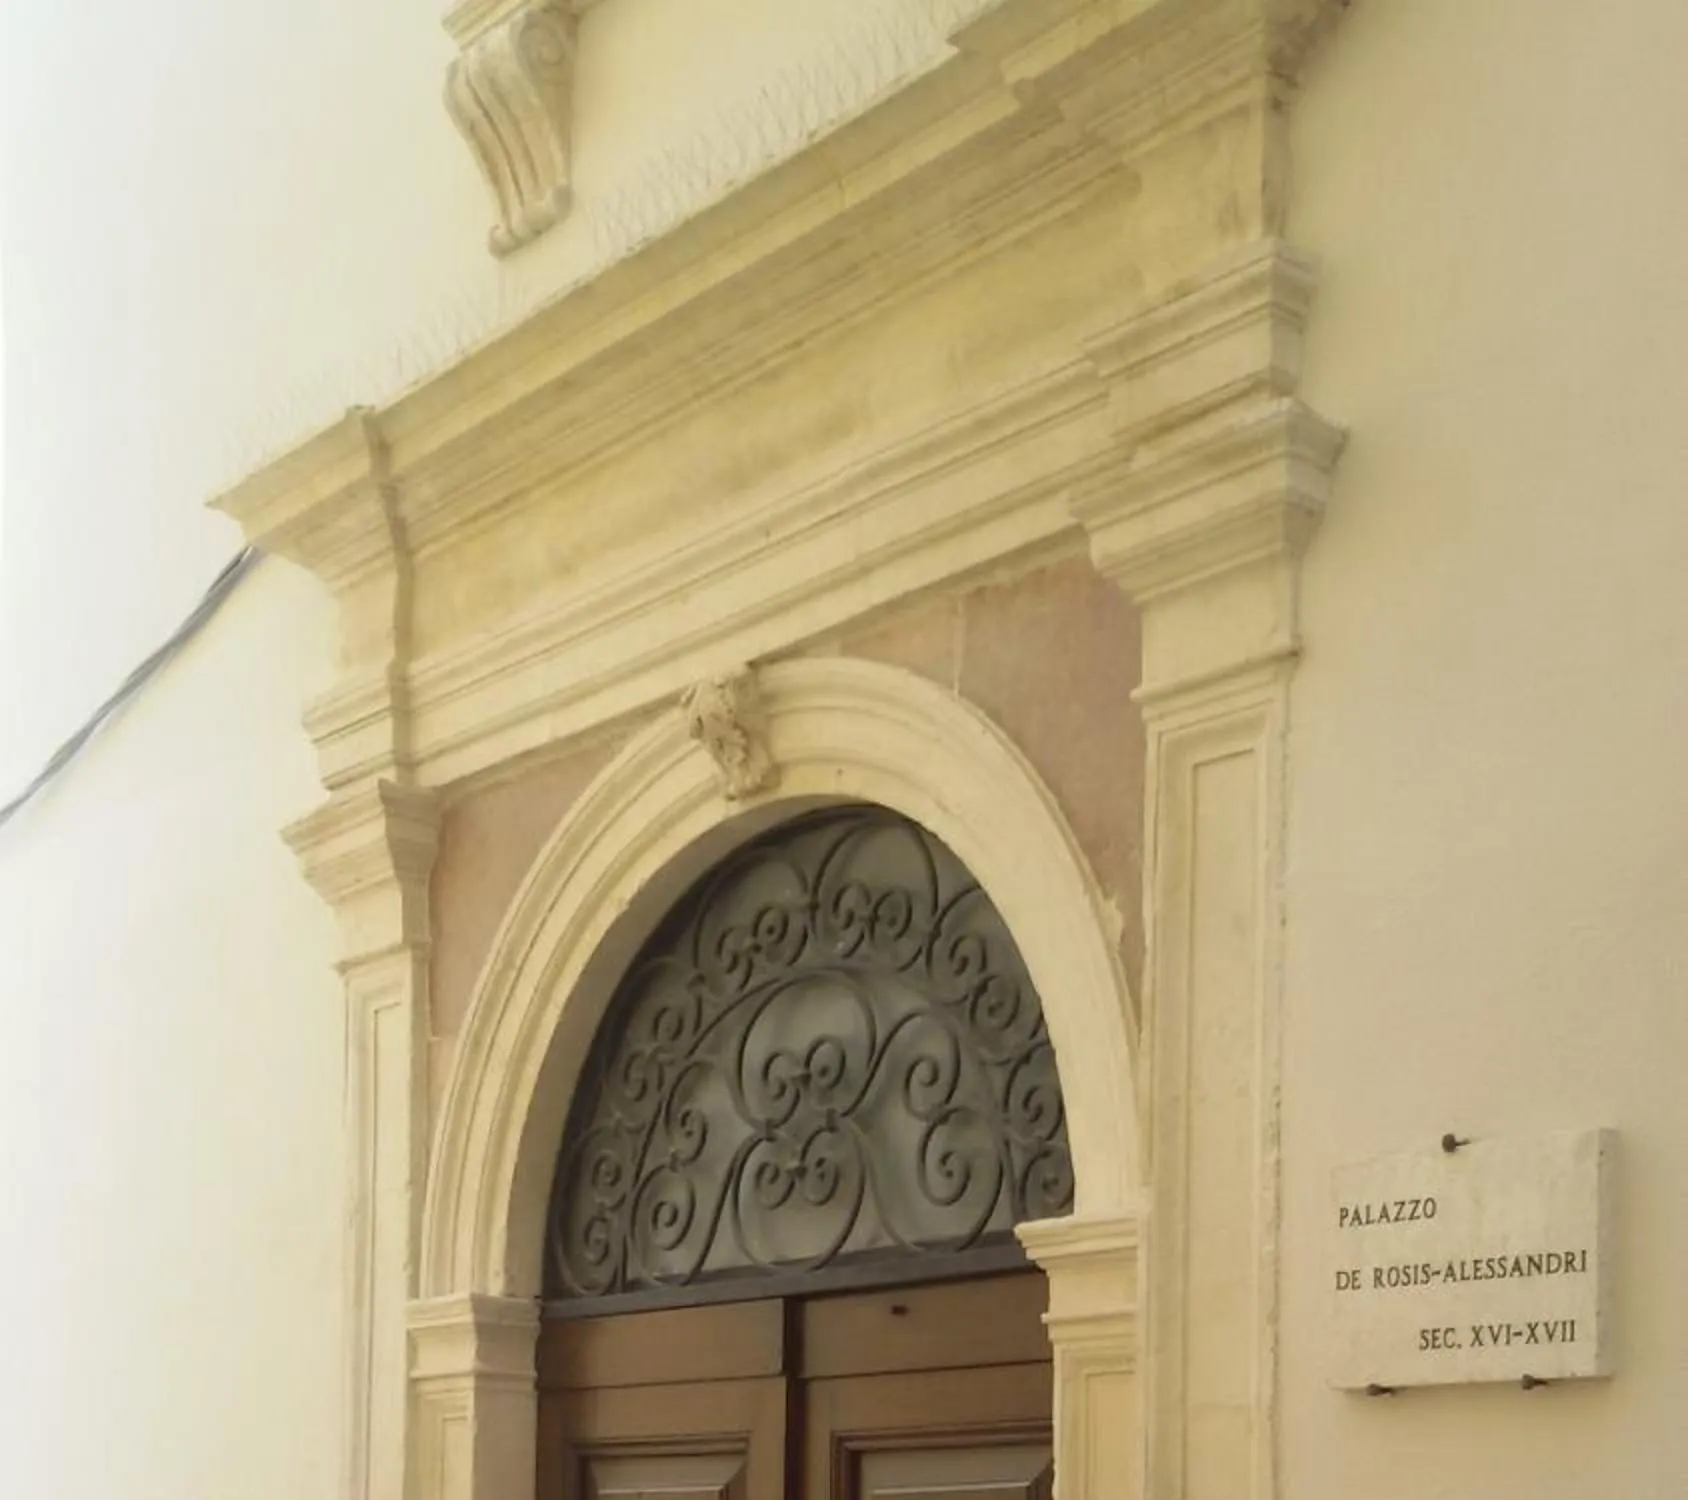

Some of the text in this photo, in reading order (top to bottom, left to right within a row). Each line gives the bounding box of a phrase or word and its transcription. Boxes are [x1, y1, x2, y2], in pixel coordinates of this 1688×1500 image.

[1339, 1197, 1437, 1228] PALAZZO
[1335, 1250, 1587, 1291] DE ROSIS-ALESSANDRI
[1419, 1319, 1576, 1351] SEC. XVI-XVII
